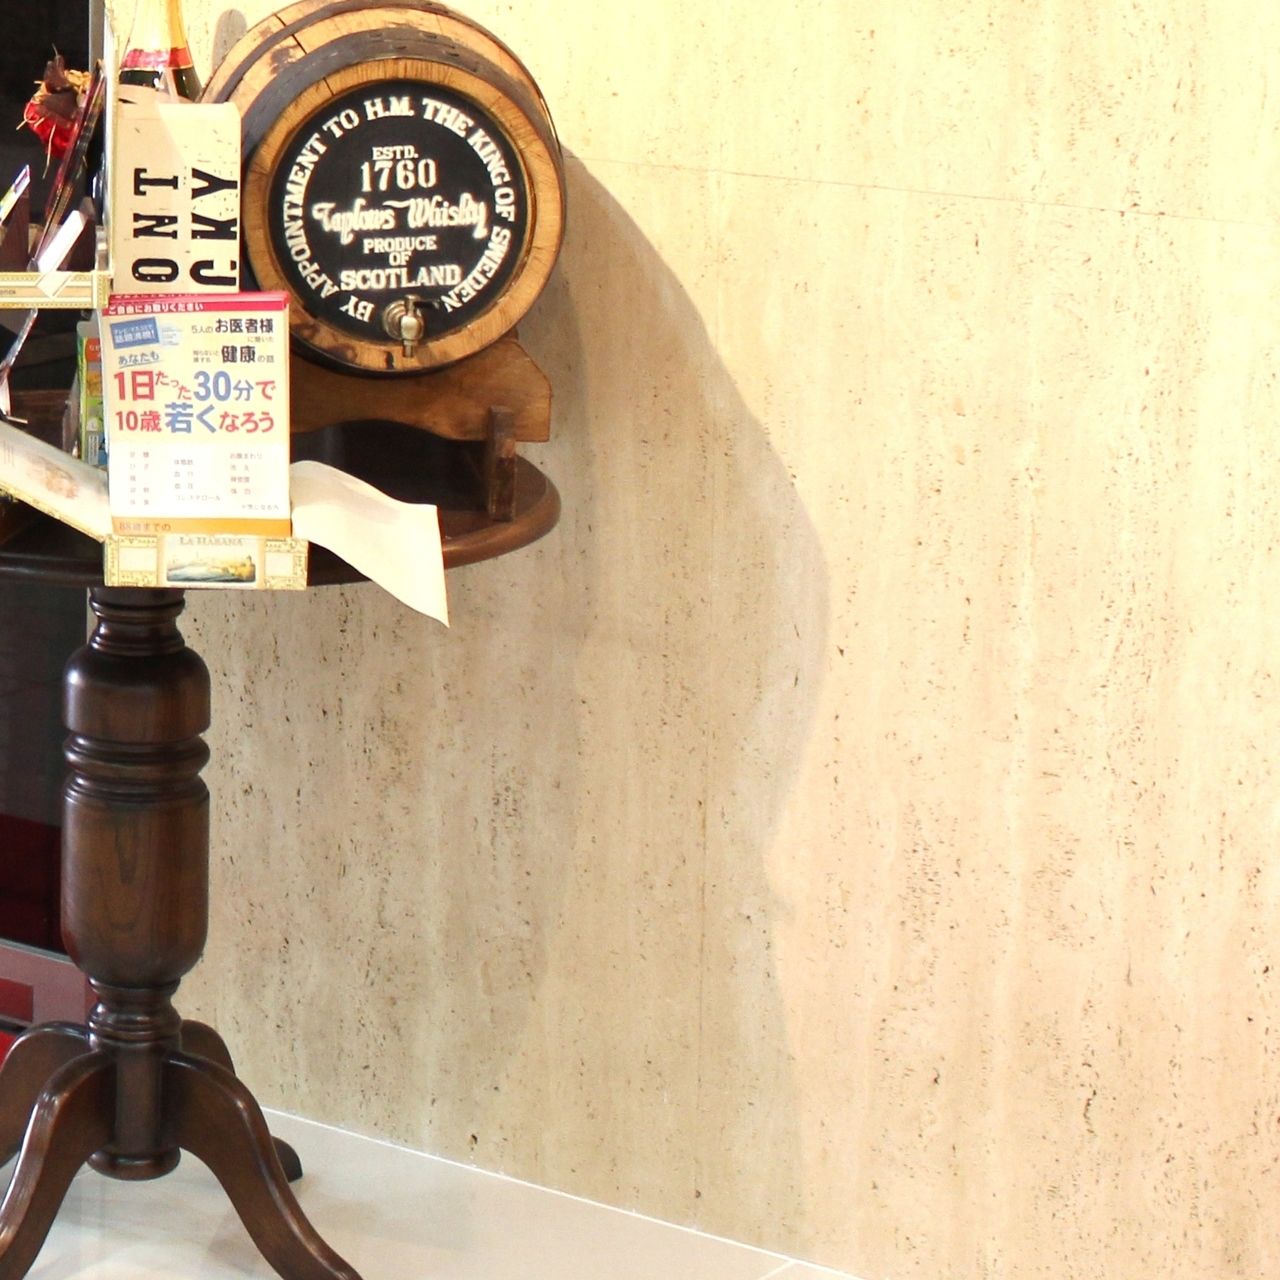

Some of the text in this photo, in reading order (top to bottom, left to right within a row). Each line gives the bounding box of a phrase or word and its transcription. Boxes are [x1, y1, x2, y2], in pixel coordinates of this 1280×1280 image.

[371, 144, 420, 161] ESTD.
[360, 158, 437, 193] 1760
[282, 96, 516, 322] BY APPOINTMENT TO H.M. THE KING OF SWEDEN
[362, 235, 438, 254] PRODUCE
[388, 250, 412, 267] OF
[339, 263, 463, 292] SCOTLAND
[107, 302, 205, 316] ご自由にお取りください
[118, 350, 160, 366] あなたも
[113, 370, 277, 402] 1日たった30分で
[115, 401, 275, 435] 10歳若くなろう
